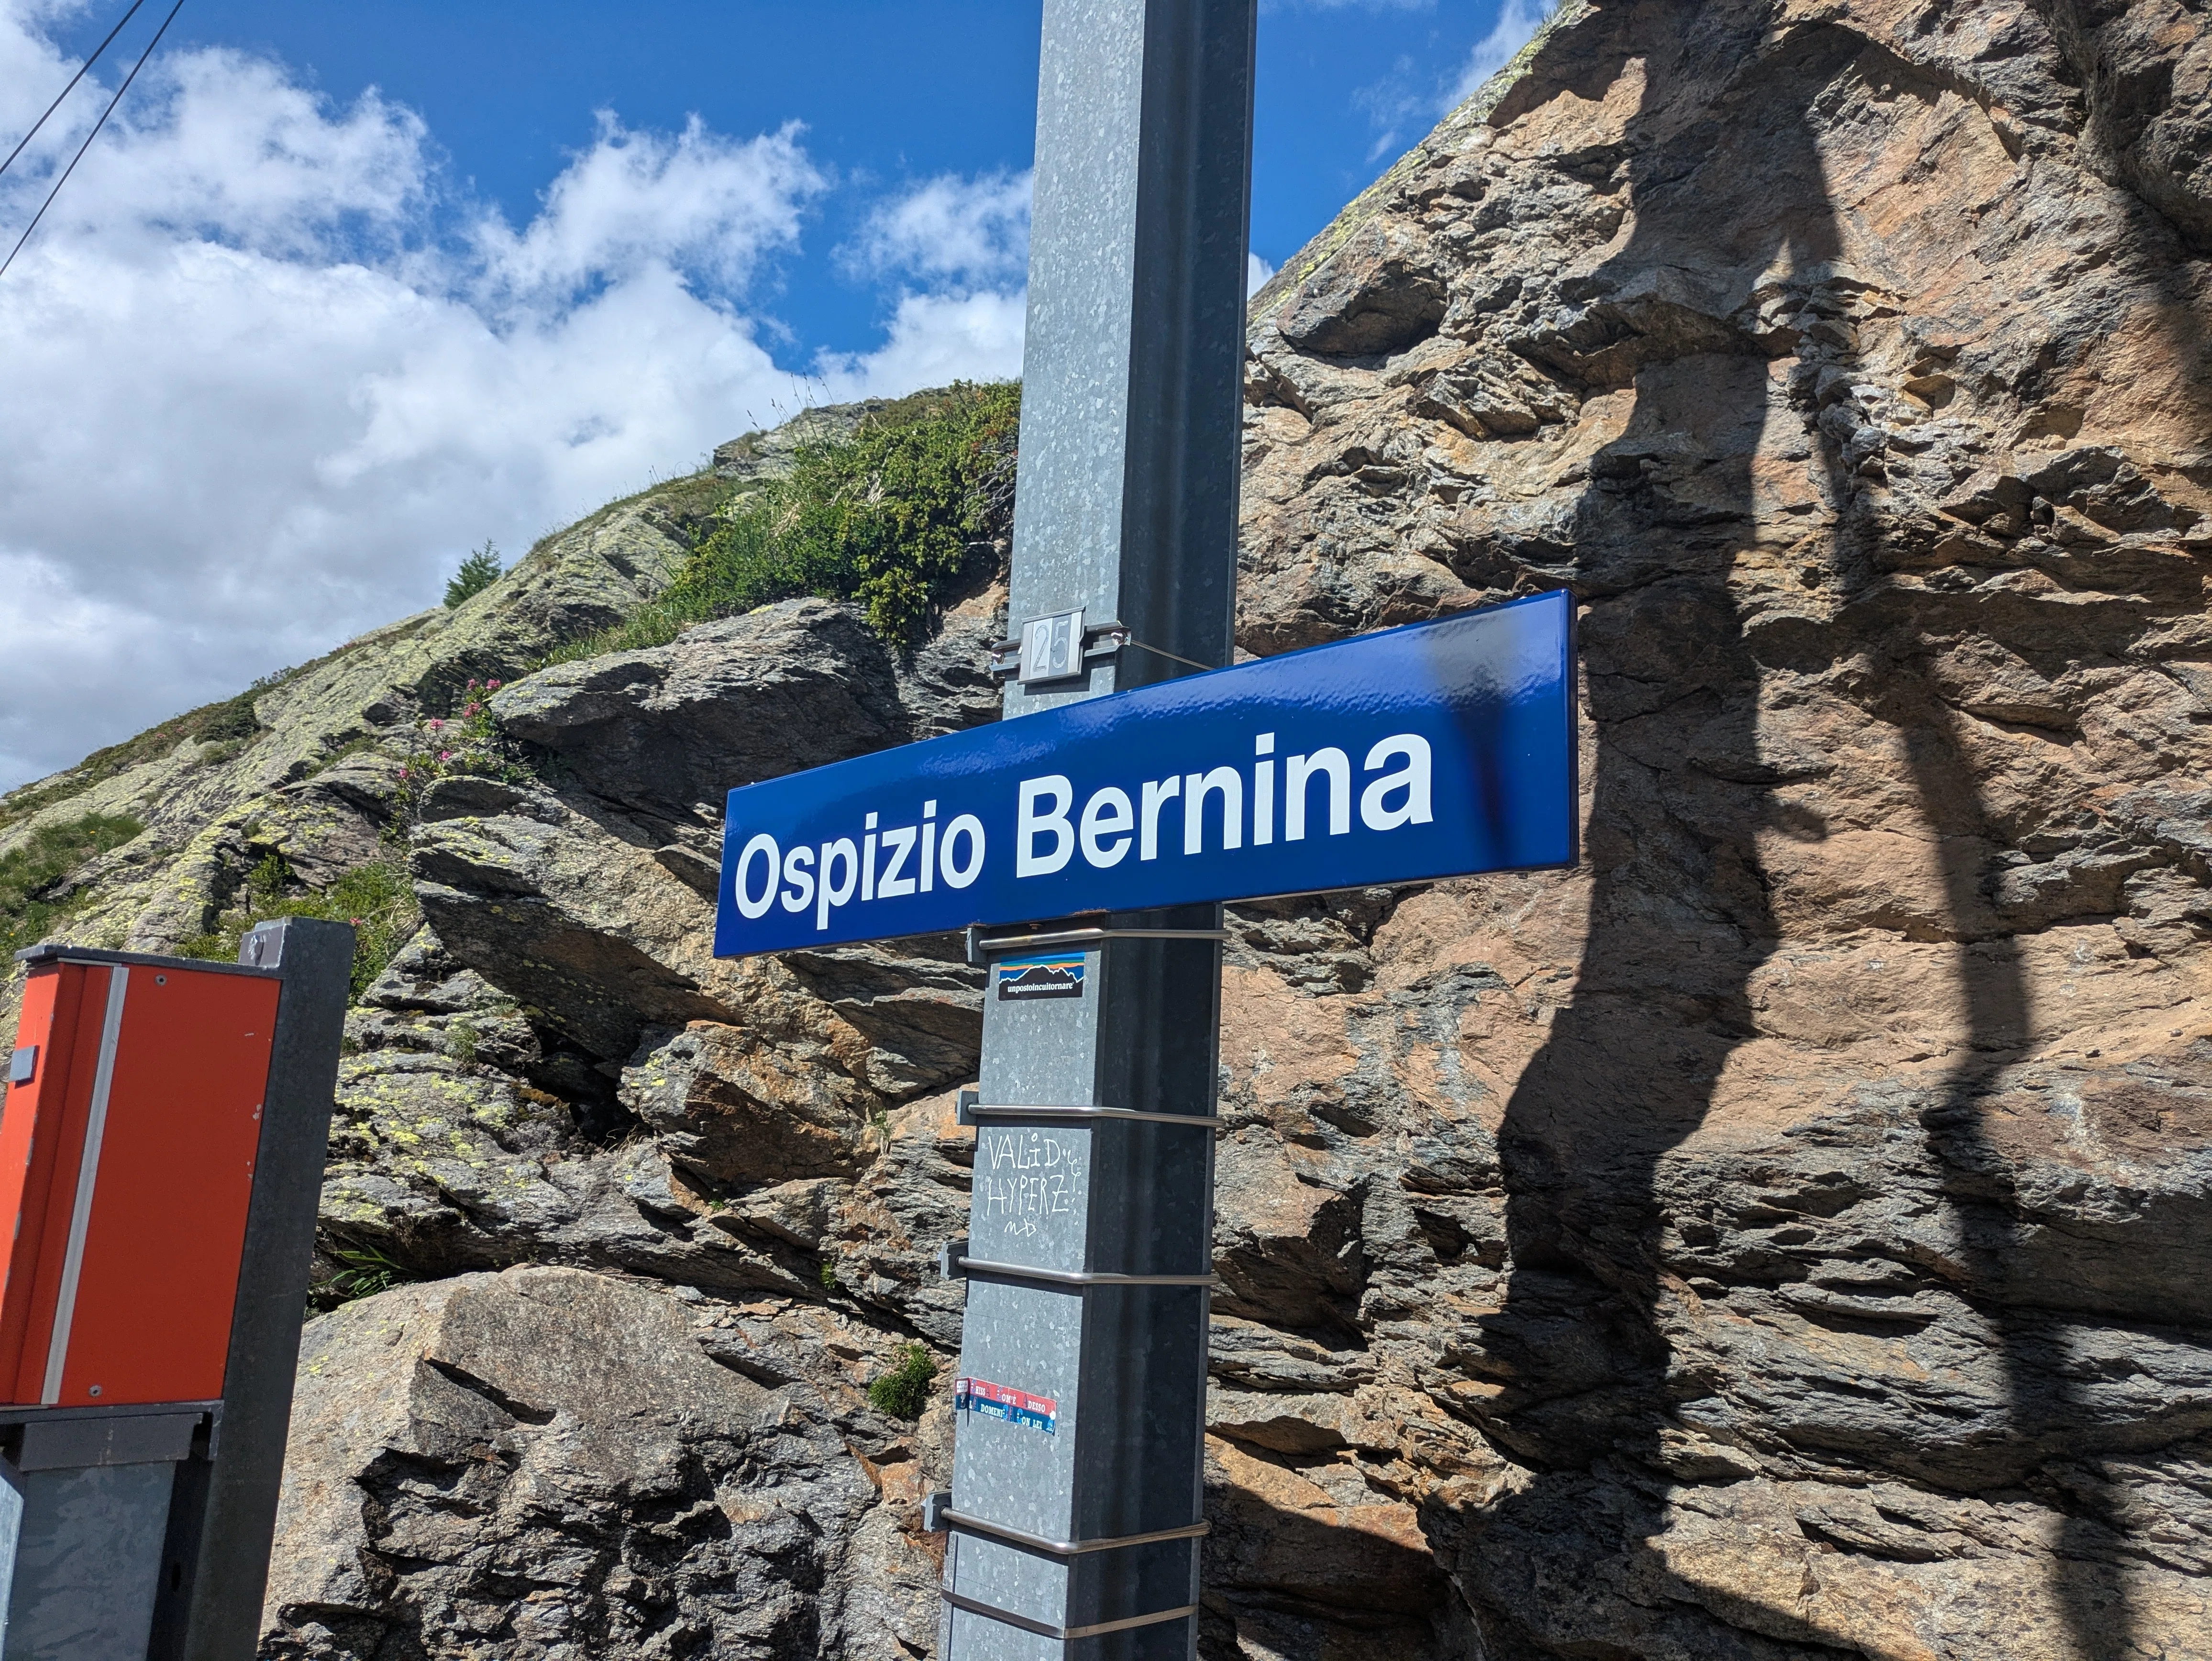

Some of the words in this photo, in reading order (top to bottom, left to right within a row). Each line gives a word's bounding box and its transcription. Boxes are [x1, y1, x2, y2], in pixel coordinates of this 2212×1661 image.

[1034, 620, 1069, 672] 25
[736, 799, 985, 930] Ospizio
[1017, 732, 1434, 878] Bernina
[1007, 982, 1073, 994] unpostoincuitornare
[1022, 1393, 1046, 1413] ADESSO
[980, 1404, 1014, 1422] DOMENICA
[1017, 1408, 1031, 1426] CON
[1032, 1419, 1043, 1430] LEI
